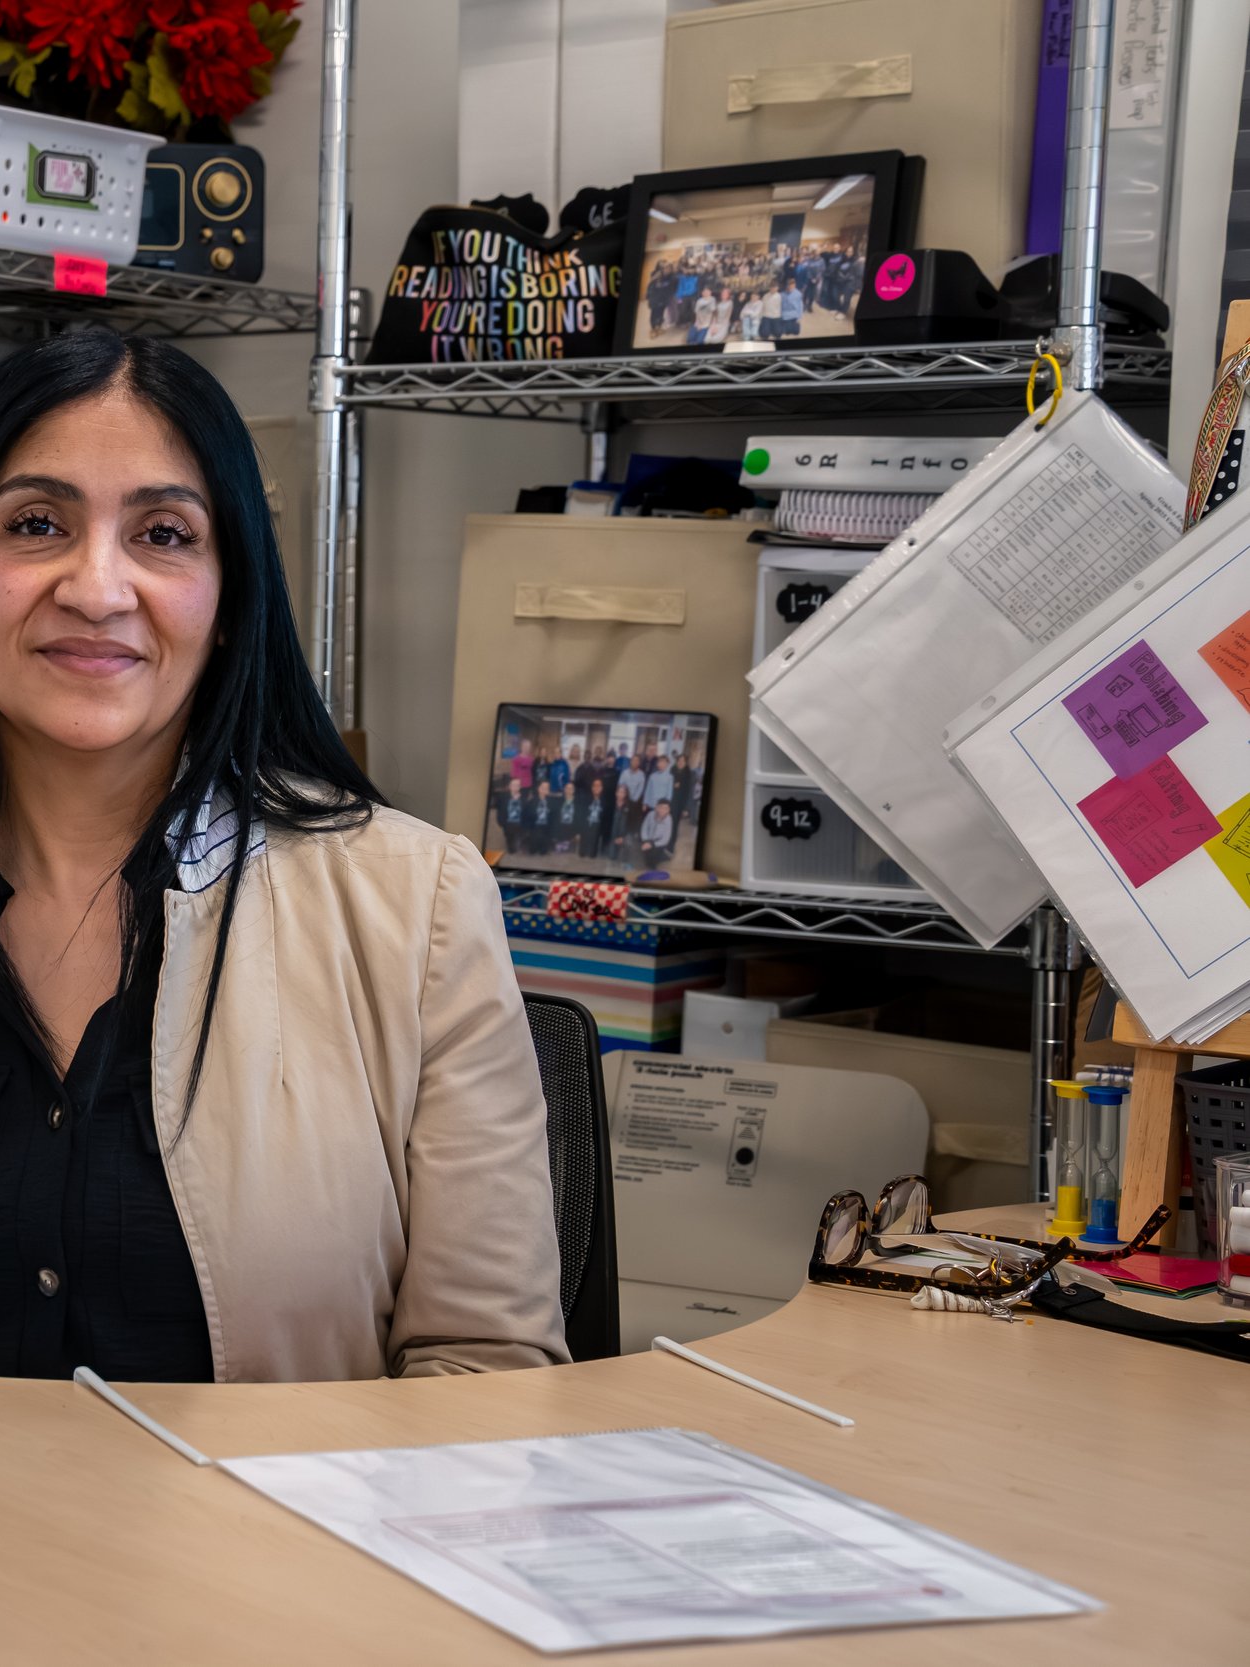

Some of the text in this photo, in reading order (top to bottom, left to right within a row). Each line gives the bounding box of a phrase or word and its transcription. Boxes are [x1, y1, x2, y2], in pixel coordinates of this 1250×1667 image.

[431, 229, 584, 275] IF YOU THINK
[388, 264, 623, 299] READING IS BORING
[419, 298, 595, 336] YOU'RE DOING
[431, 335, 565, 363] IT WRONG
[1128, 650, 1186, 729] Publishing
[1148, 758, 1191, 820] Editing
[769, 805, 812, 828] 9-12
